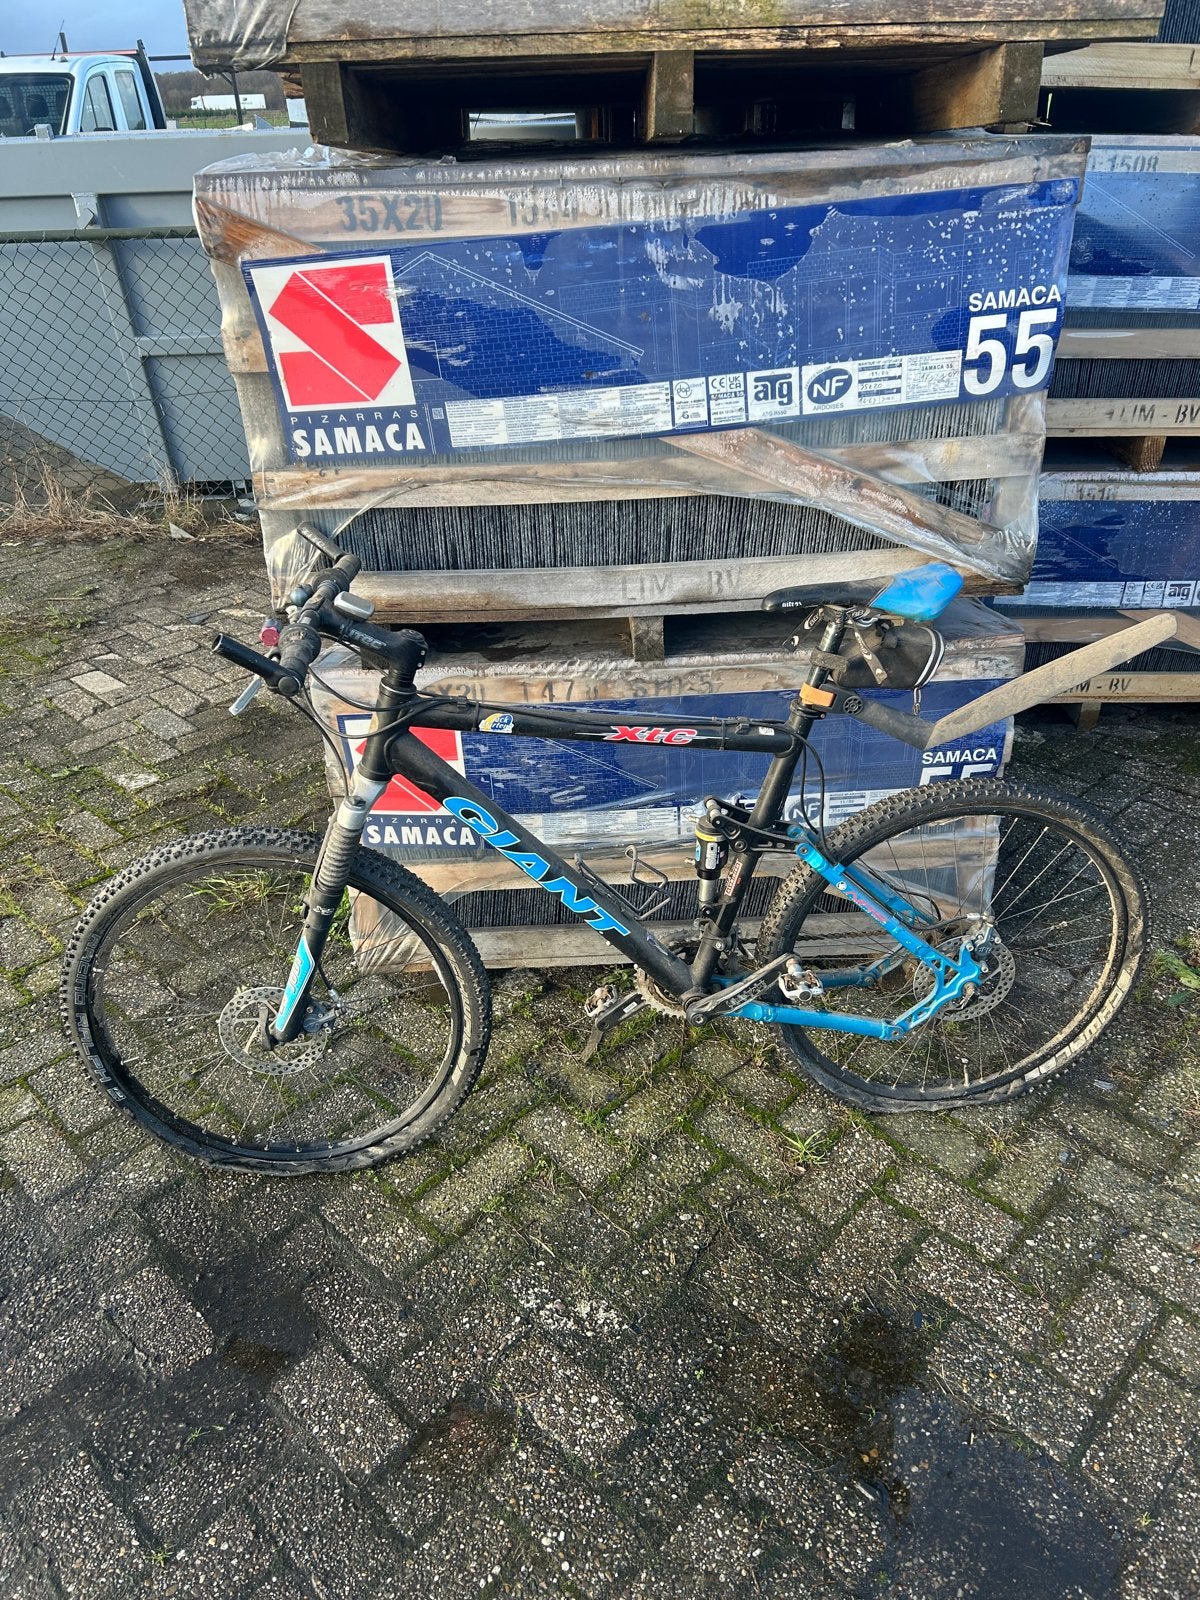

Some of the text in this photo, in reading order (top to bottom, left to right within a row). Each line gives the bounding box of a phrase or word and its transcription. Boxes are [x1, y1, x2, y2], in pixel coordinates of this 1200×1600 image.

[336, 194, 443, 232] 35X20
[968, 285, 1061, 312] SAMACA
[963, 308, 1058, 395] 55
[812, 374, 849, 398] NF
[291, 409, 418, 425] PIZARRAS
[293, 423, 426, 457] SAMACA
[922, 748, 997, 764] SAMACA
[366, 816, 458, 824] PIZARRA
[366, 825, 476, 846] SAMACA
[443, 796, 631, 937] GIANT
[75, 1012, 112, 1083] RALPH
